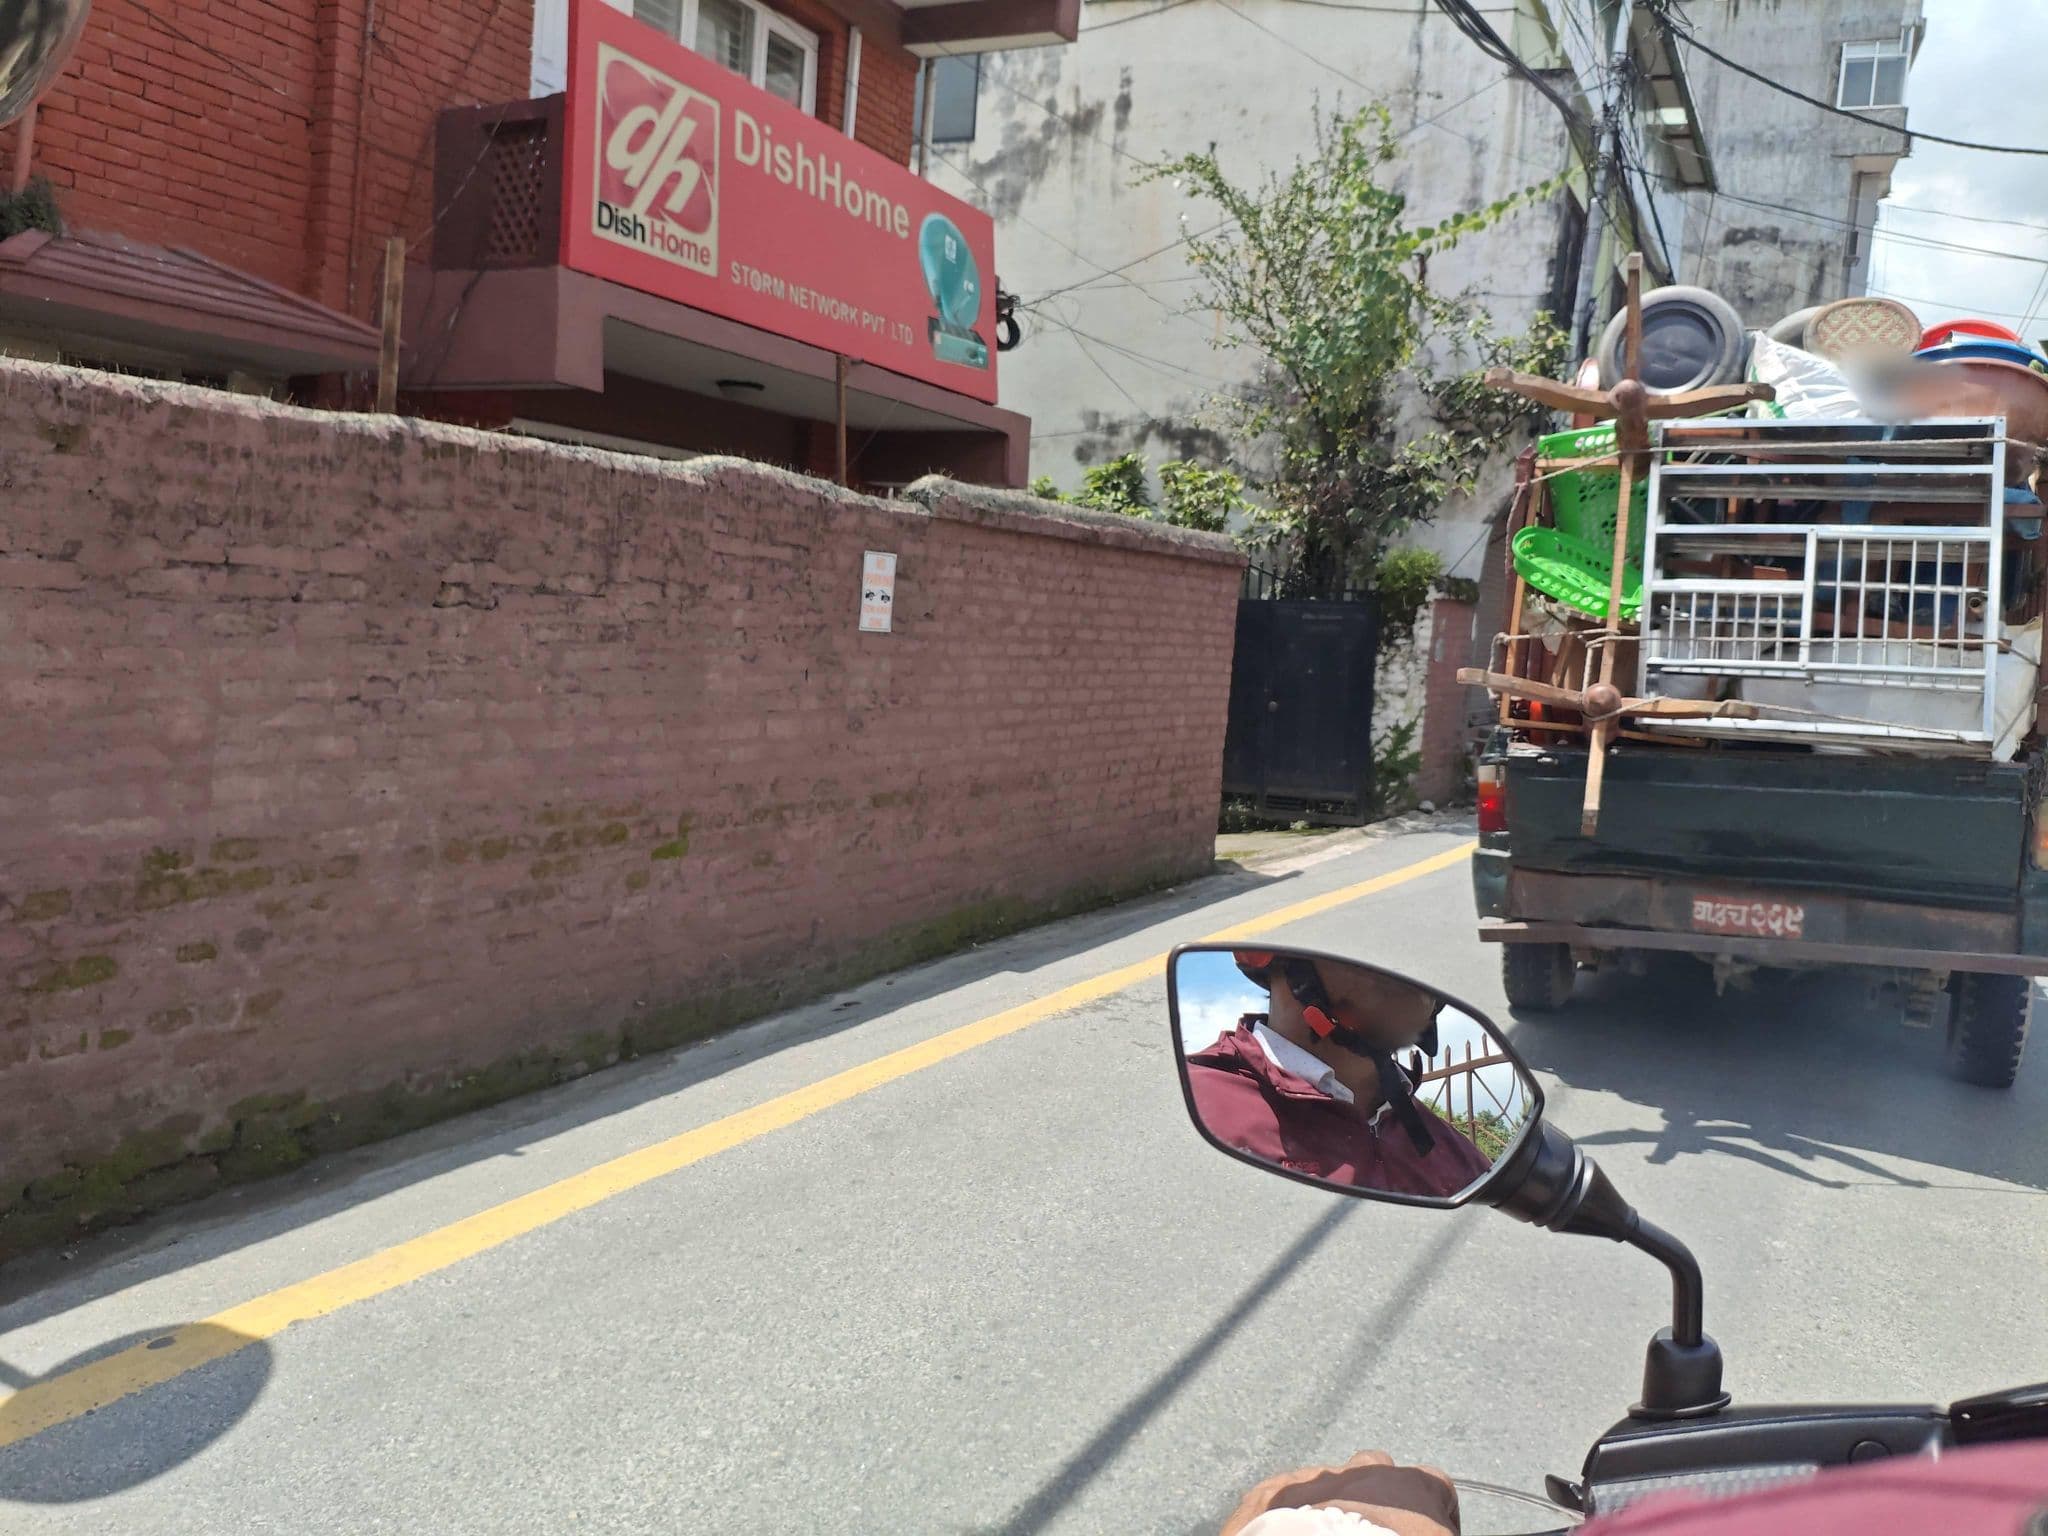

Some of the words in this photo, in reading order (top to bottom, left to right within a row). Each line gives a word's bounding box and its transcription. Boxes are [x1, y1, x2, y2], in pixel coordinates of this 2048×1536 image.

[735, 109, 910, 239] DishHome
[731, 261, 785, 300] STORM
[789, 283, 858, 327] NETWORK
[890, 321, 913, 345] LTD
